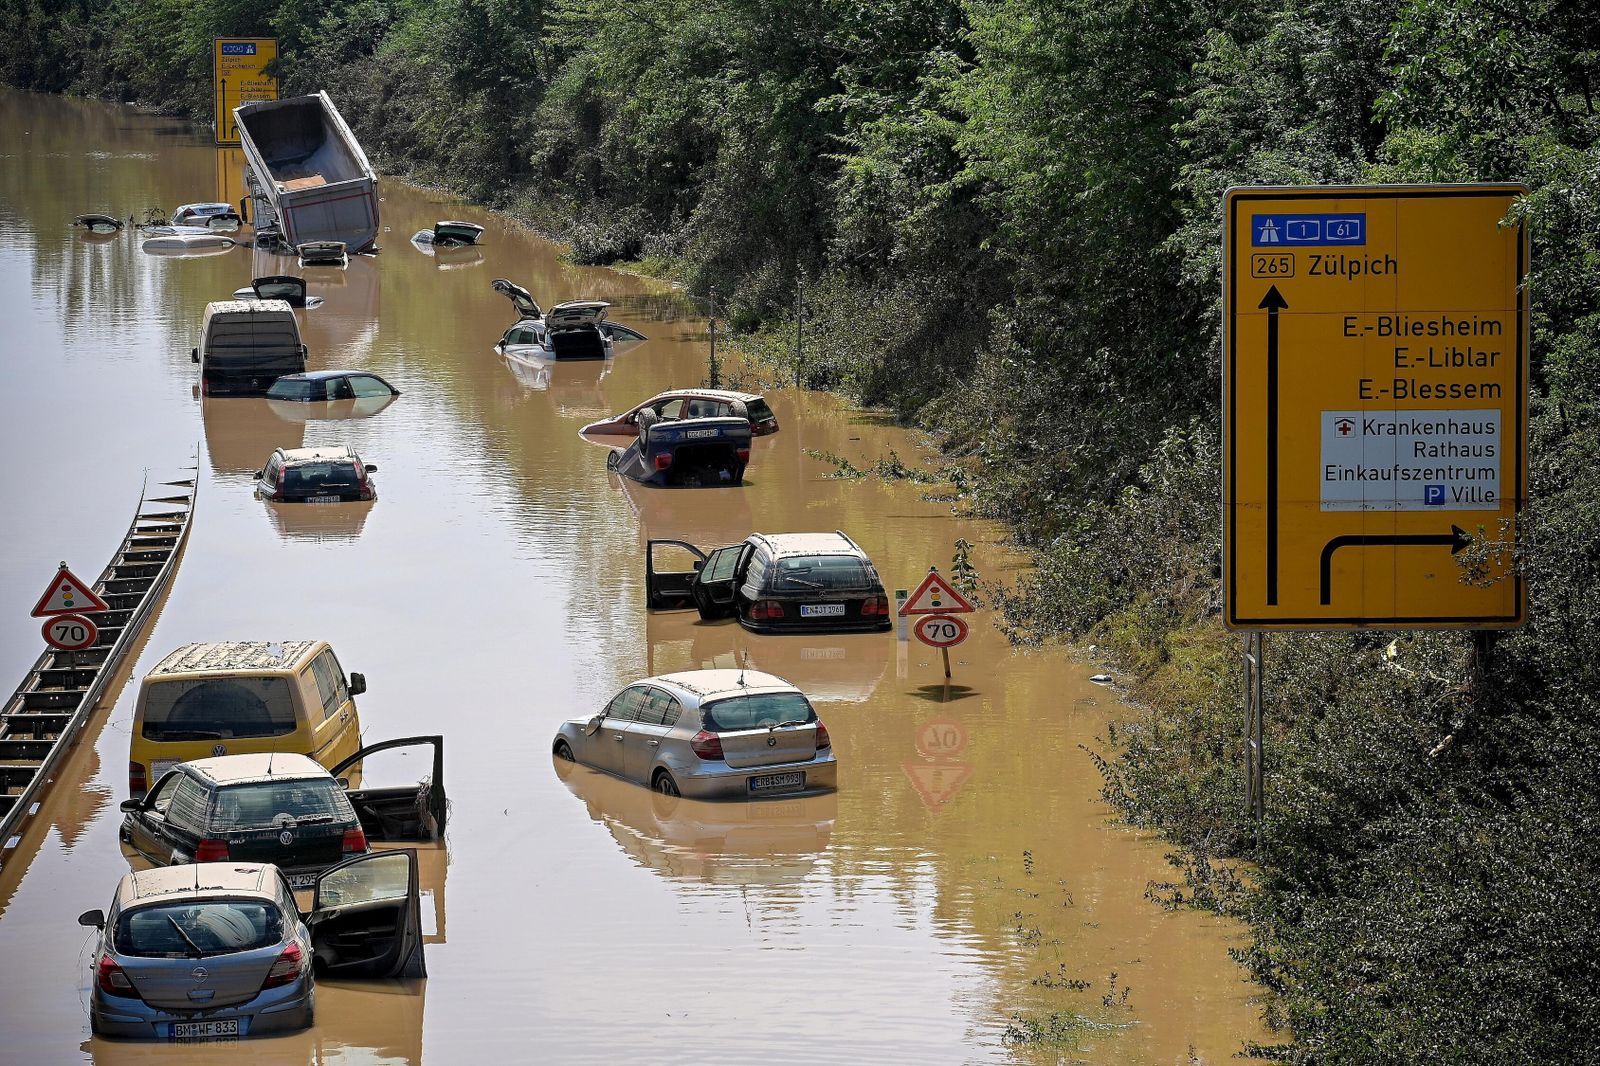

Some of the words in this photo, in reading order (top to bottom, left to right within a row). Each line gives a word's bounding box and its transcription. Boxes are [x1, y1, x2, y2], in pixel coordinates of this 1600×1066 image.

[1300, 224, 1306, 236] 1
[1337, 223, 1350, 236] 61
[1257, 258, 1289, 274] 265
[1308, 255, 1398, 280] Zülpich
[1343, 316, 1502, 337] E.-Bliesheim
[1394, 347, 1501, 368] E.-Liblar
[1359, 378, 1501, 400] E.-Blessem
[1363, 418, 1495, 436] Krankenhaus
[1414, 441, 1495, 458] Rathaus
[1325, 464, 1495, 482] Einkaufszentrum
[1451, 486, 1495, 503] Ville
[806, 606, 814, 614] EN
[55, 626, 85, 641] 70
[927, 624, 956, 639] 70
[755, 777, 770, 787] ERB
[775, 776, 784, 785] SM
[785, 773, 799, 783] 993
[299, 874, 316, 885] 295
[175, 1024, 191, 1036] BM
[198, 1023, 213, 1035] WF
[215, 1021, 237, 1033] 833
